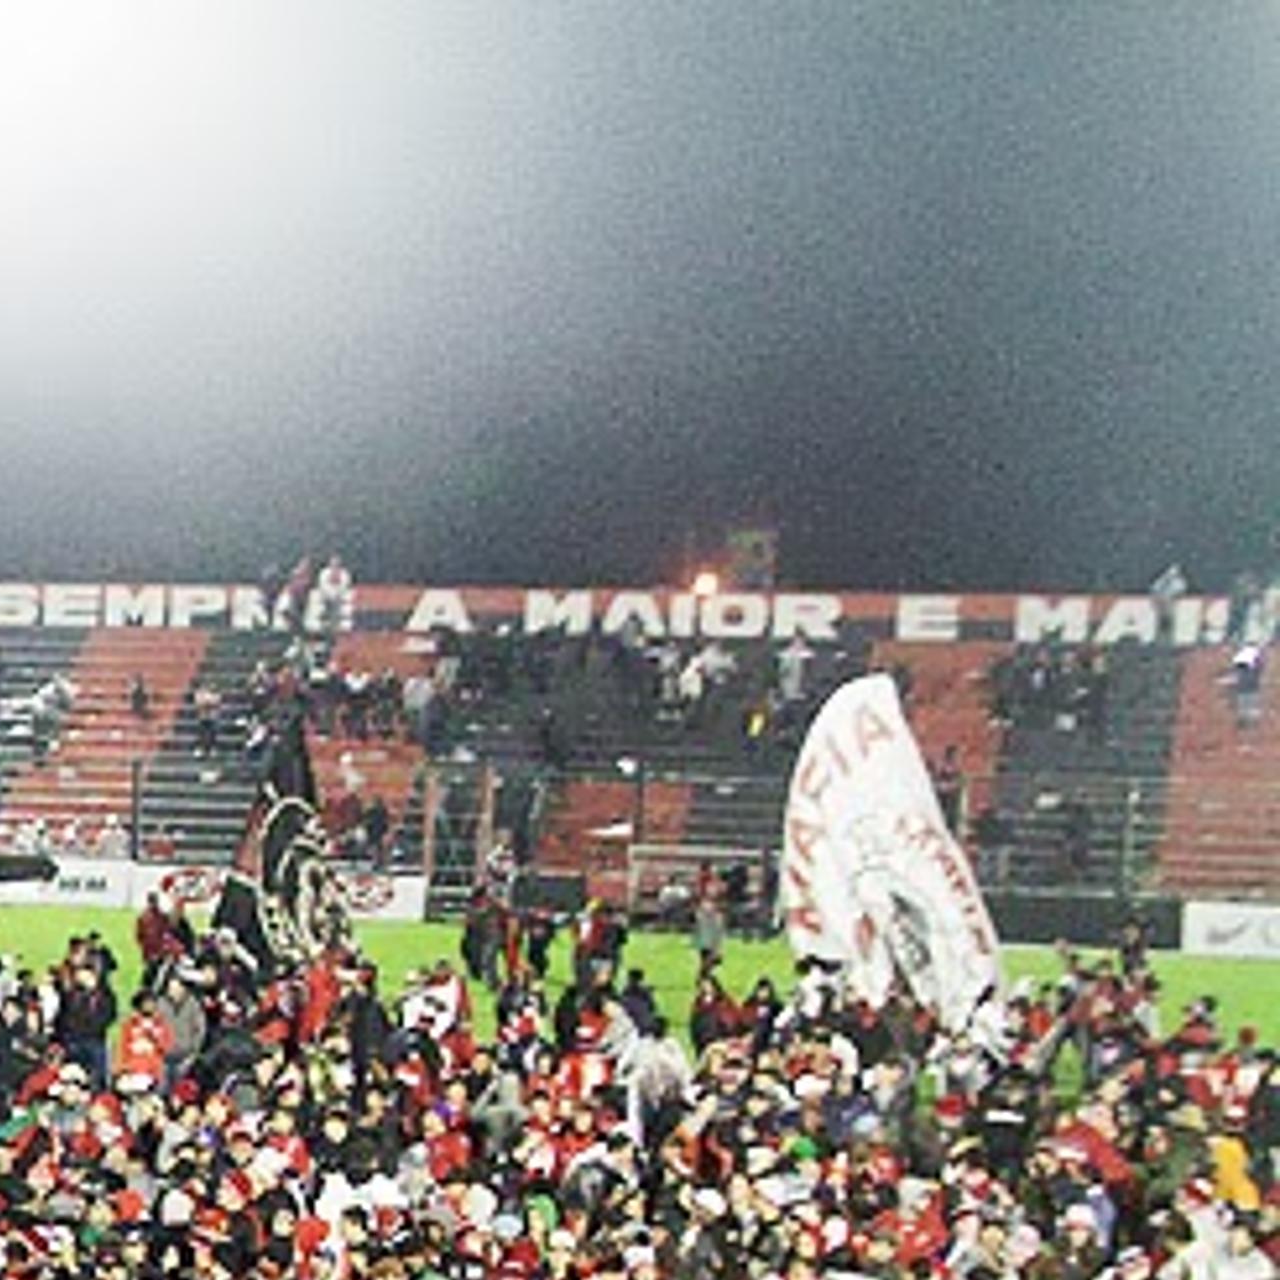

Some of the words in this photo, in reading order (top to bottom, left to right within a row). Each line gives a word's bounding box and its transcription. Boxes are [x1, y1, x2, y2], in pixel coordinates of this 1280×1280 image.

[405, 590, 472, 634] A
[525, 590, 842, 639] MAIOR
[897, 596, 958, 640] E
